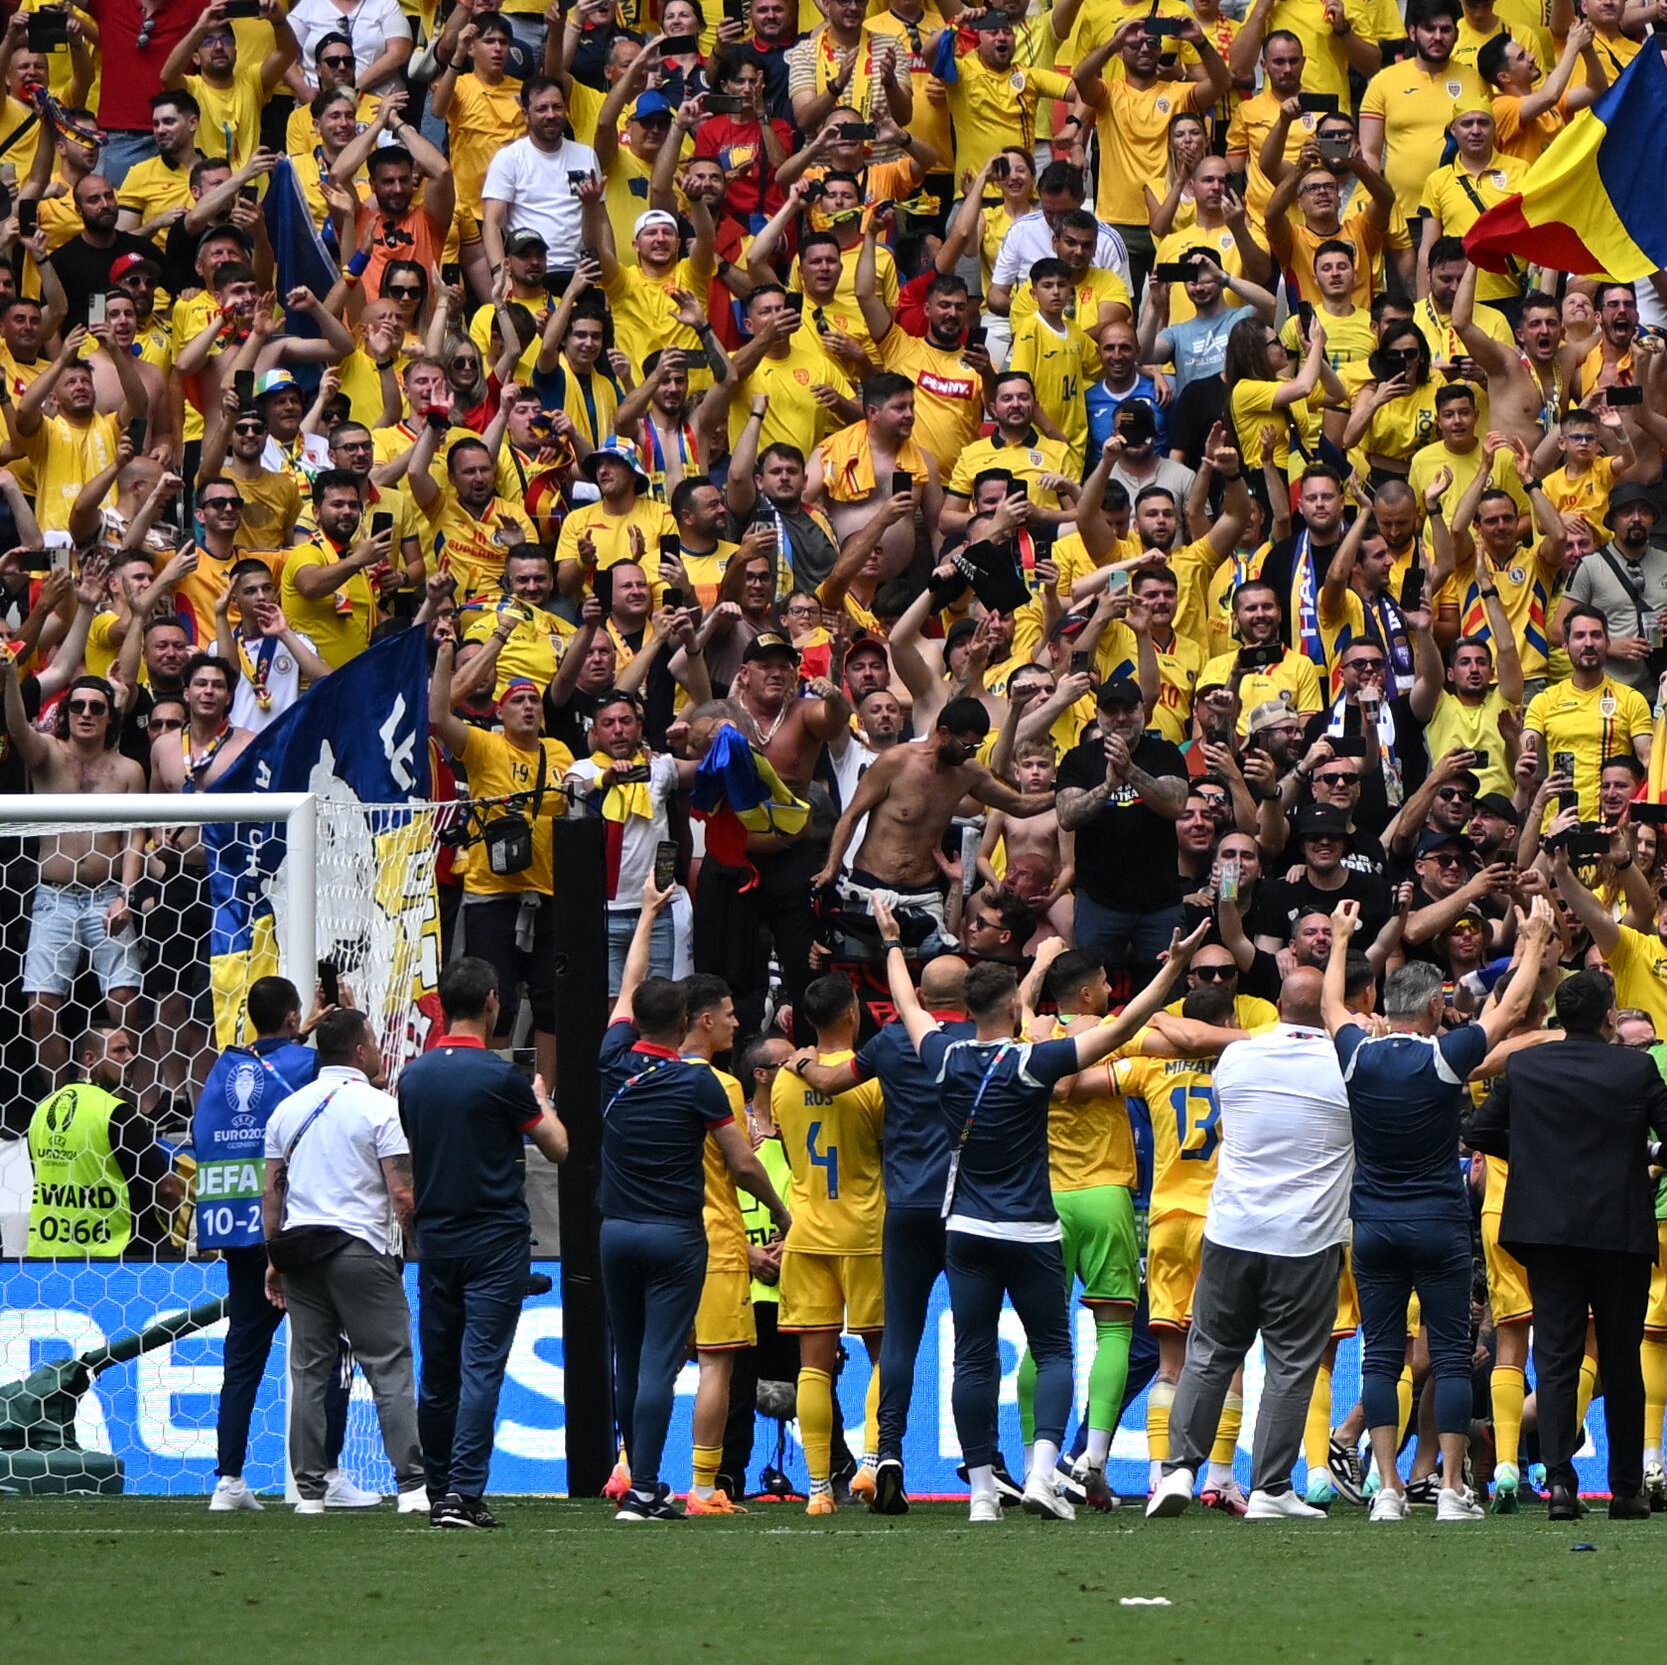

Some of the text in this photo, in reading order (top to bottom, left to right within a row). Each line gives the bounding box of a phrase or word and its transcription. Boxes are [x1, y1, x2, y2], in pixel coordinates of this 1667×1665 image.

[922, 374, 970, 395] PENNY.
[447, 539, 507, 561] SUPERBE
[1170, 1087, 1221, 1161] 13
[807, 1122, 838, 1199] 4
[31, 1184, 117, 1210] EWARD
[203, 1205, 262, 1237] 10-2
